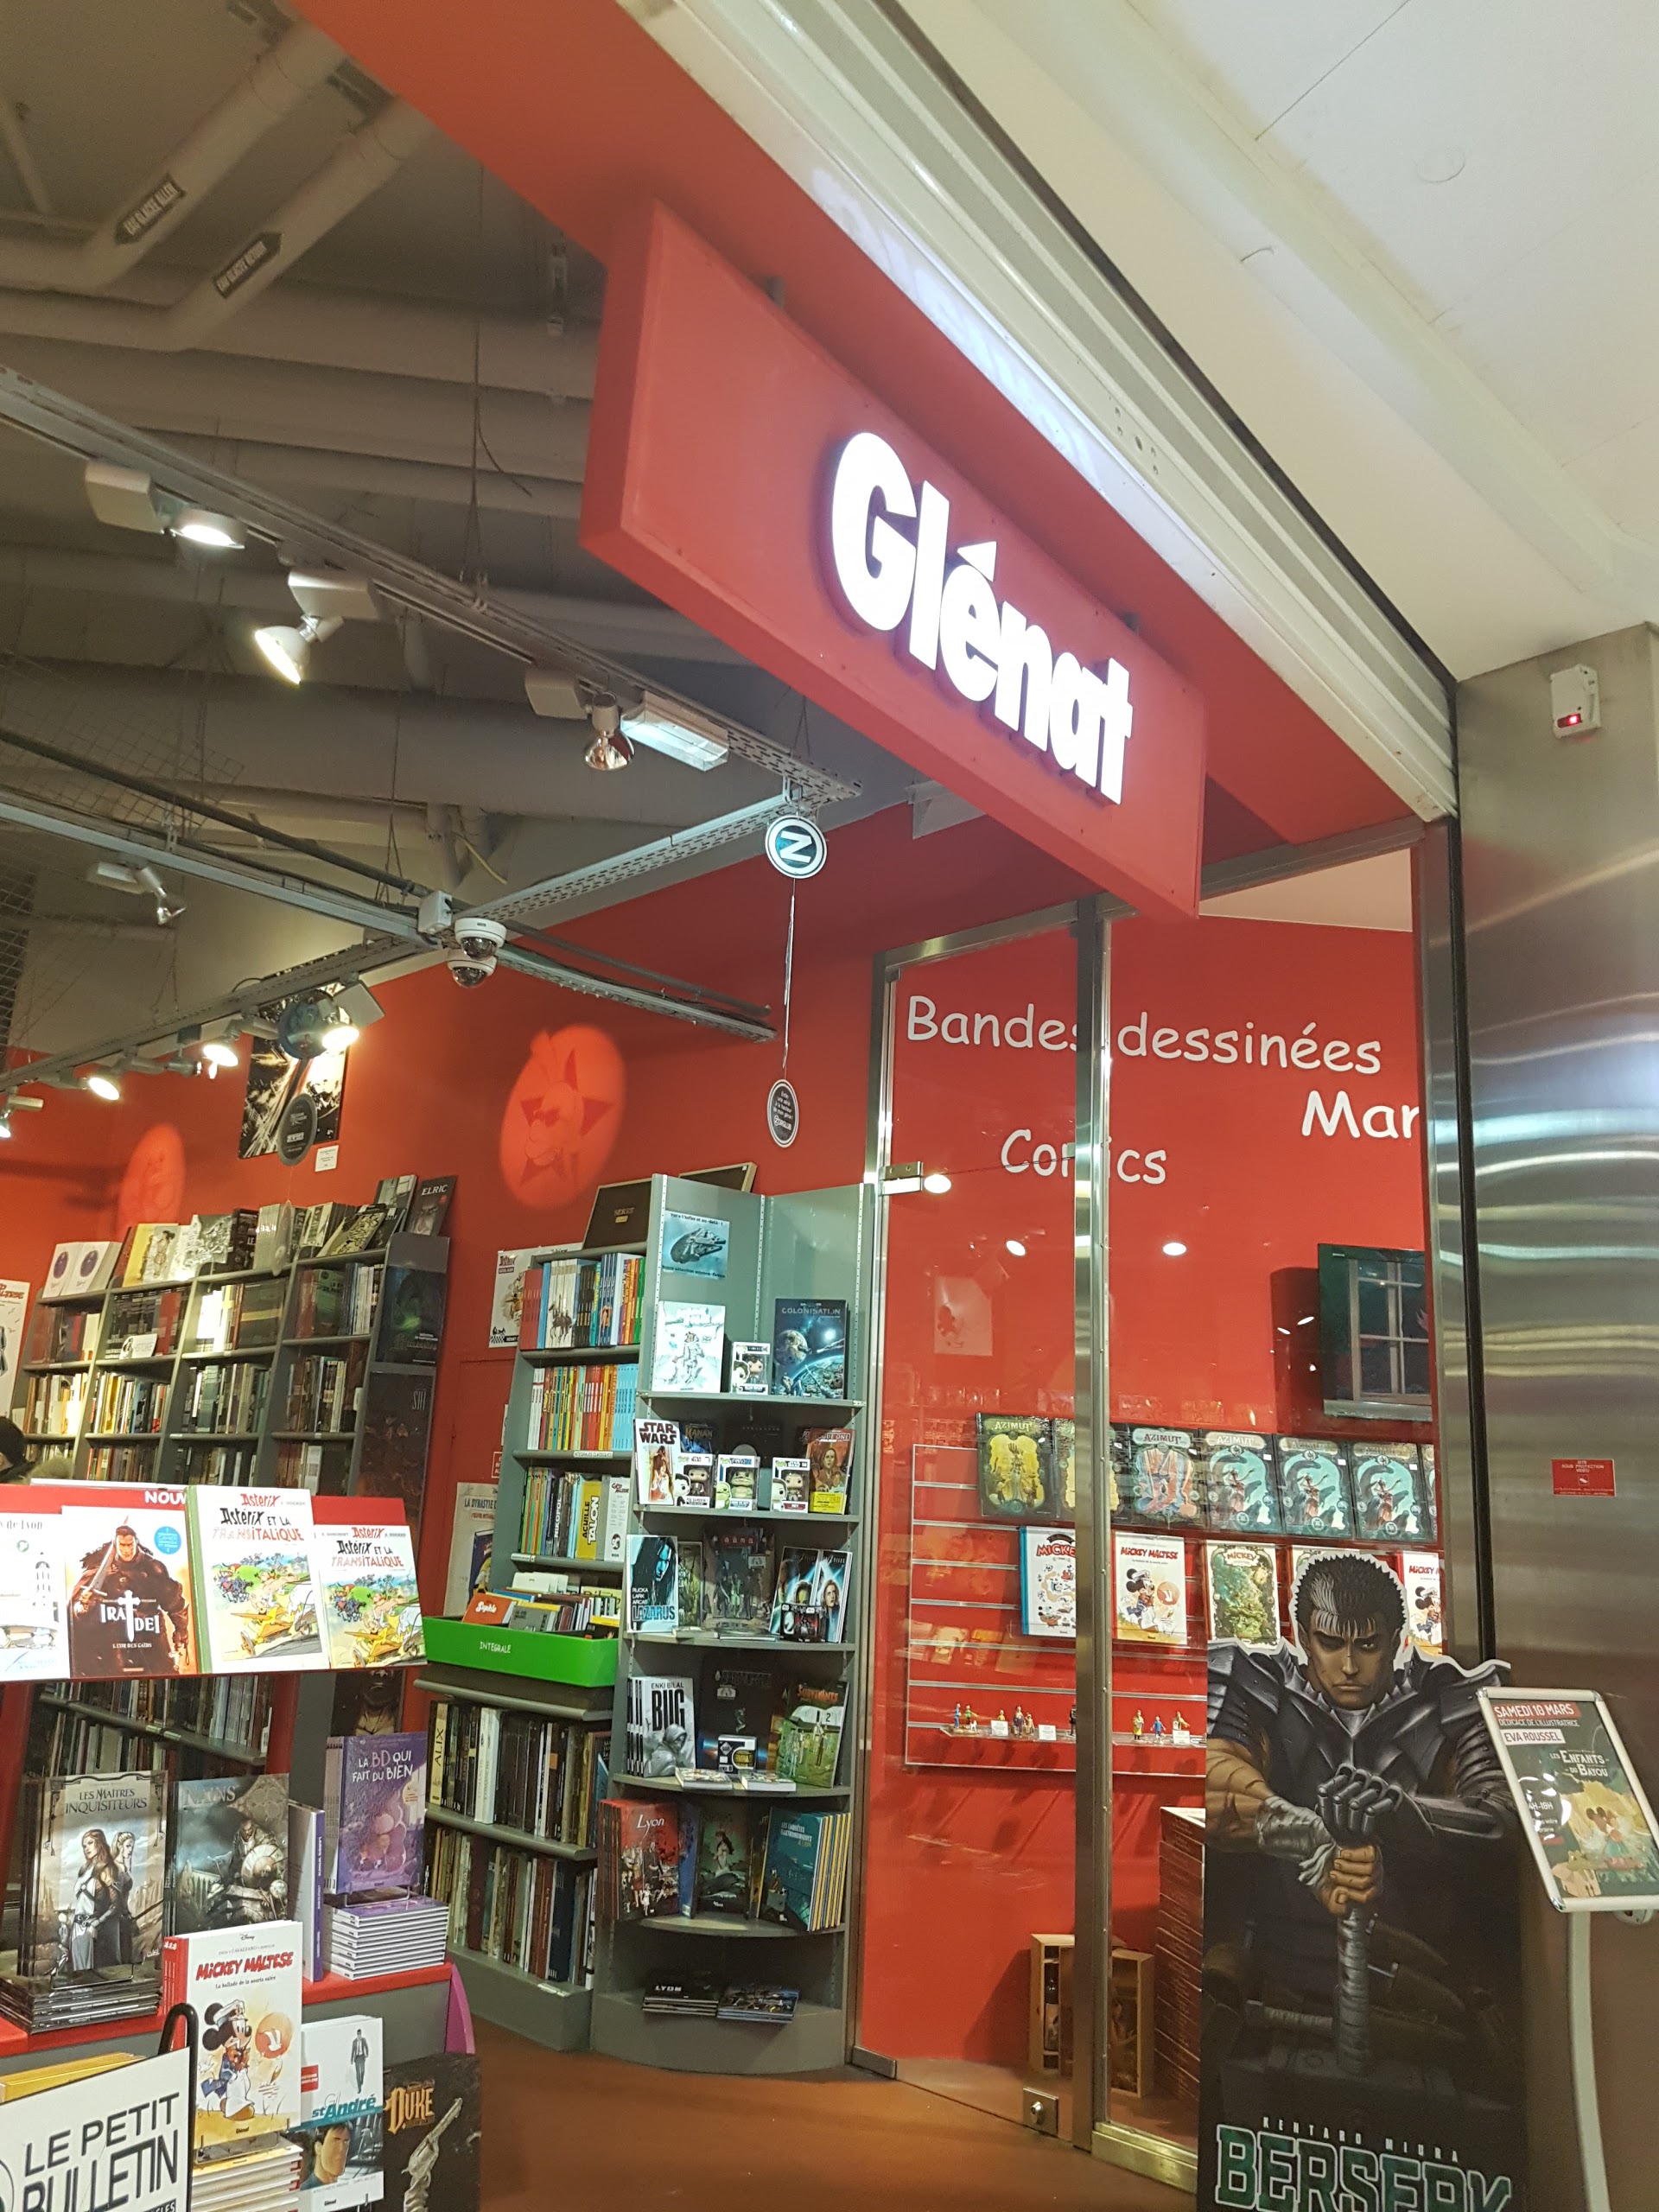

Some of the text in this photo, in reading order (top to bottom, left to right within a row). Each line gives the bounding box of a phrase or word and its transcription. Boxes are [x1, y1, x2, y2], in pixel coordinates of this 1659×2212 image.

[832, 432, 1133, 805] Glénat
[1117, 1012, 1382, 1074] dessinées
[421, 1184, 448, 1196] ELRIC
[781, 1306, 841, 1315] COLONISATION
[639, 1422, 677, 1433] STAR
[994, 1421, 1033, 1432] AZIMUT
[639, 1433, 677, 1444] WARS
[1143, 1433, 1182, 1444] AZIMUT
[1217, 1435, 1255, 1446] AZIMUT
[219, 1508, 265, 1525] Astérix
[554, 1497, 563, 1538] NIKOPOL
[588, 1496, 600, 1545] TALON
[337, 1541, 394, 1554] Astérix ET LA
[1121, 1547, 1179, 1560] MICKEY MALTESE
[1408, 1565, 1435, 1574] MICKEY
[100, 1605, 126, 1623] IRA
[632, 1605, 676, 1621] LAZARUS
[135, 1614, 160, 1633] DEI
[652, 1688, 685, 1732] BUG
[1494, 1705, 1531, 1718] SAMEDI
[1545, 1703, 1574, 1715] MARS
[1503, 1731, 1562, 1743] EVA ROUSSEL
[434, 1727, 445, 1767] ALIX
[358, 1750, 412, 1768] LA BD QUI
[1559, 1750, 1605, 1764] ENFANTS
[353, 1764, 414, 1783] FAIT DU BIEN
[1576, 1764, 1609, 1777] BAYOU
[79, 1789, 95, 1801] LES
[65, 1797, 148, 1815] INQUISITEURS
[637, 1815, 664, 1839] Lyon
[196, 1951, 294, 1980] MICKEY MALTESE
[383, 2086, 435, 2135] DUKE
[25, 2092, 180, 2177] LE PETIT
[1263, 2117, 1459, 2164] KENTARO MIURA
